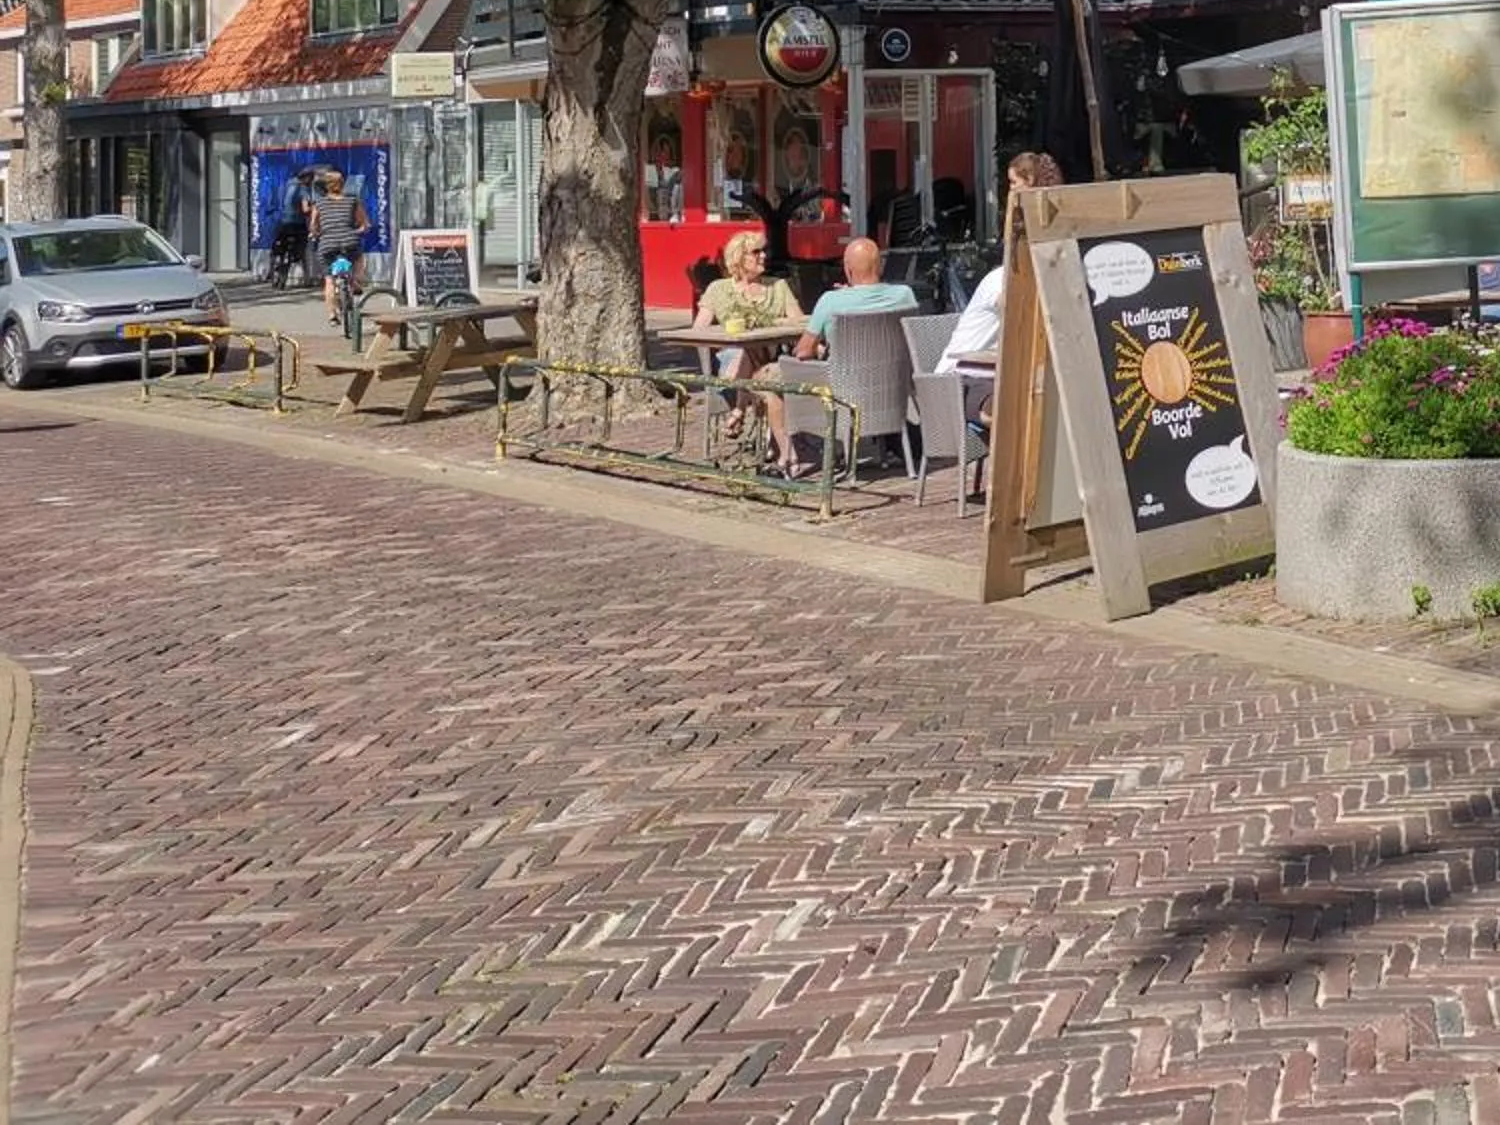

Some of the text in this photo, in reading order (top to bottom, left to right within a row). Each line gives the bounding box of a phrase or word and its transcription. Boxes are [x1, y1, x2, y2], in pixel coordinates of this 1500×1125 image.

[376, 149, 388, 247] Rabobank
[1121, 306, 1189, 327] Italiaanse
[1147, 323, 1171, 340] Bol
[1151, 401, 1203, 426] Boorde
[1168, 419, 1193, 440] Vol
